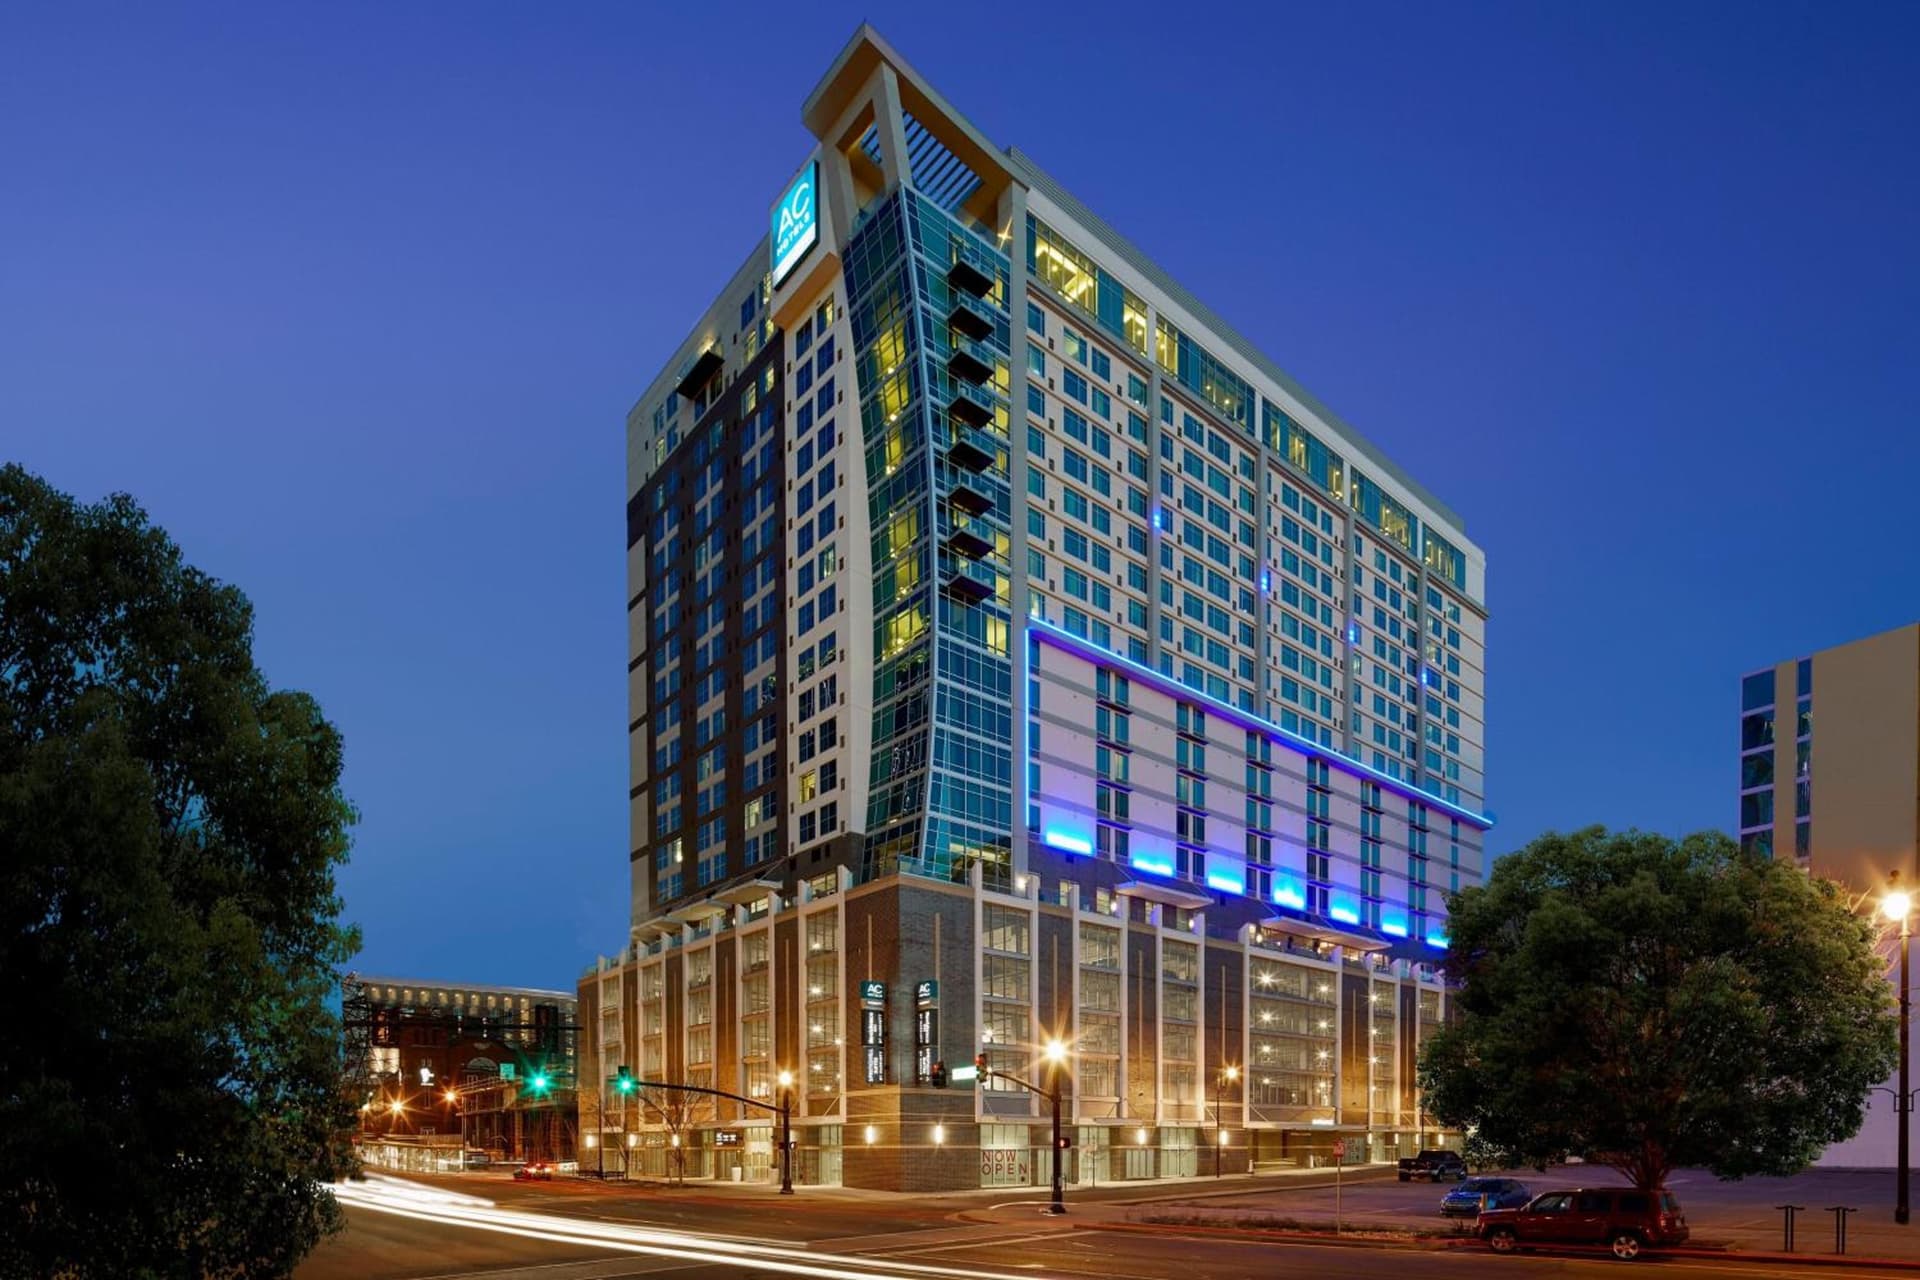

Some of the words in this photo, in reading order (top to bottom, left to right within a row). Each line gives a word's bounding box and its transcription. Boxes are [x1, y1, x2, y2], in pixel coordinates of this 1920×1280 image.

[777, 182, 809, 243] AC
[867, 983, 882, 994] AC
[919, 983, 930, 993] AC
[983, 1151, 1016, 1162] NOW
[982, 1163, 1027, 1175] OPEN
